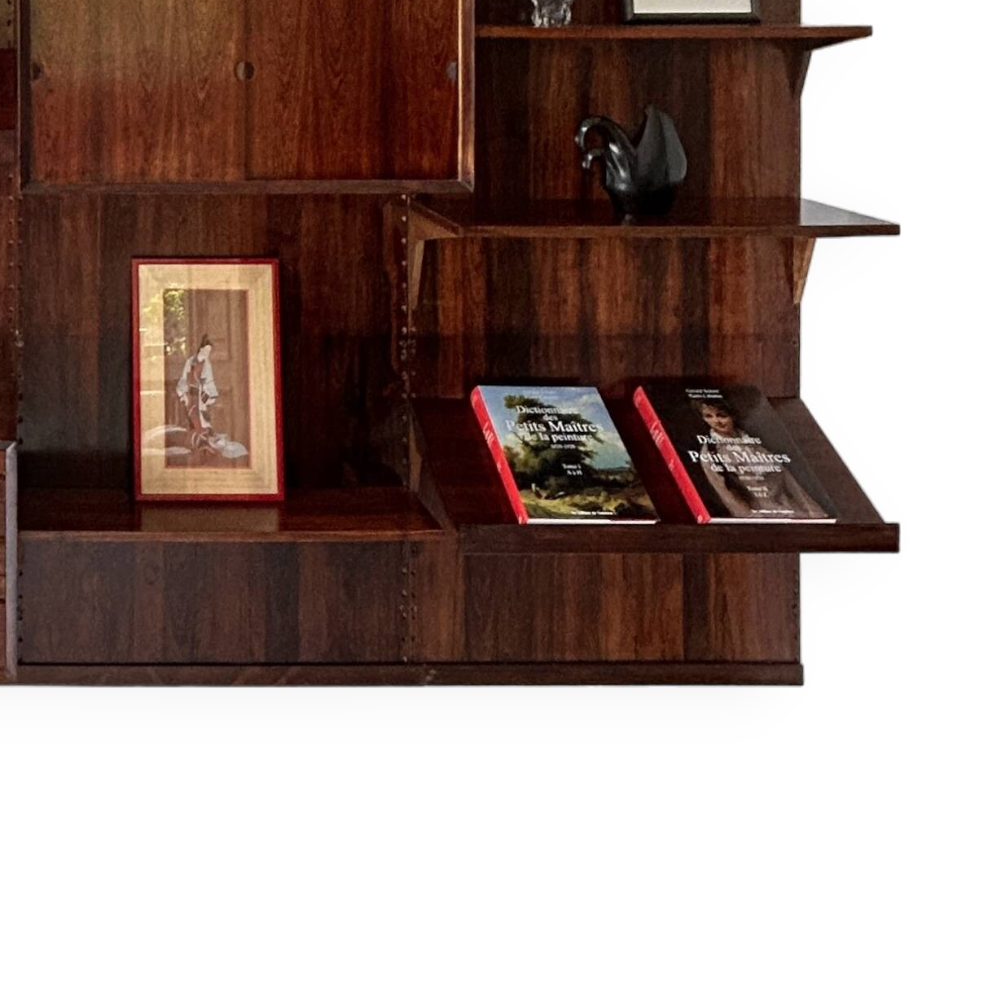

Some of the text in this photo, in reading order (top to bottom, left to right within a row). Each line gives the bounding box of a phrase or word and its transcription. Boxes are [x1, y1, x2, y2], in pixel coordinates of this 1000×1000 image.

[505, 419, 604, 433] Petits Maîtres
[538, 432, 550, 441] la
[551, 433, 593, 443] peinture
[687, 450, 791, 464] Petits Maîtres
[711, 463, 724, 472] de
[724, 463, 737, 472] la
